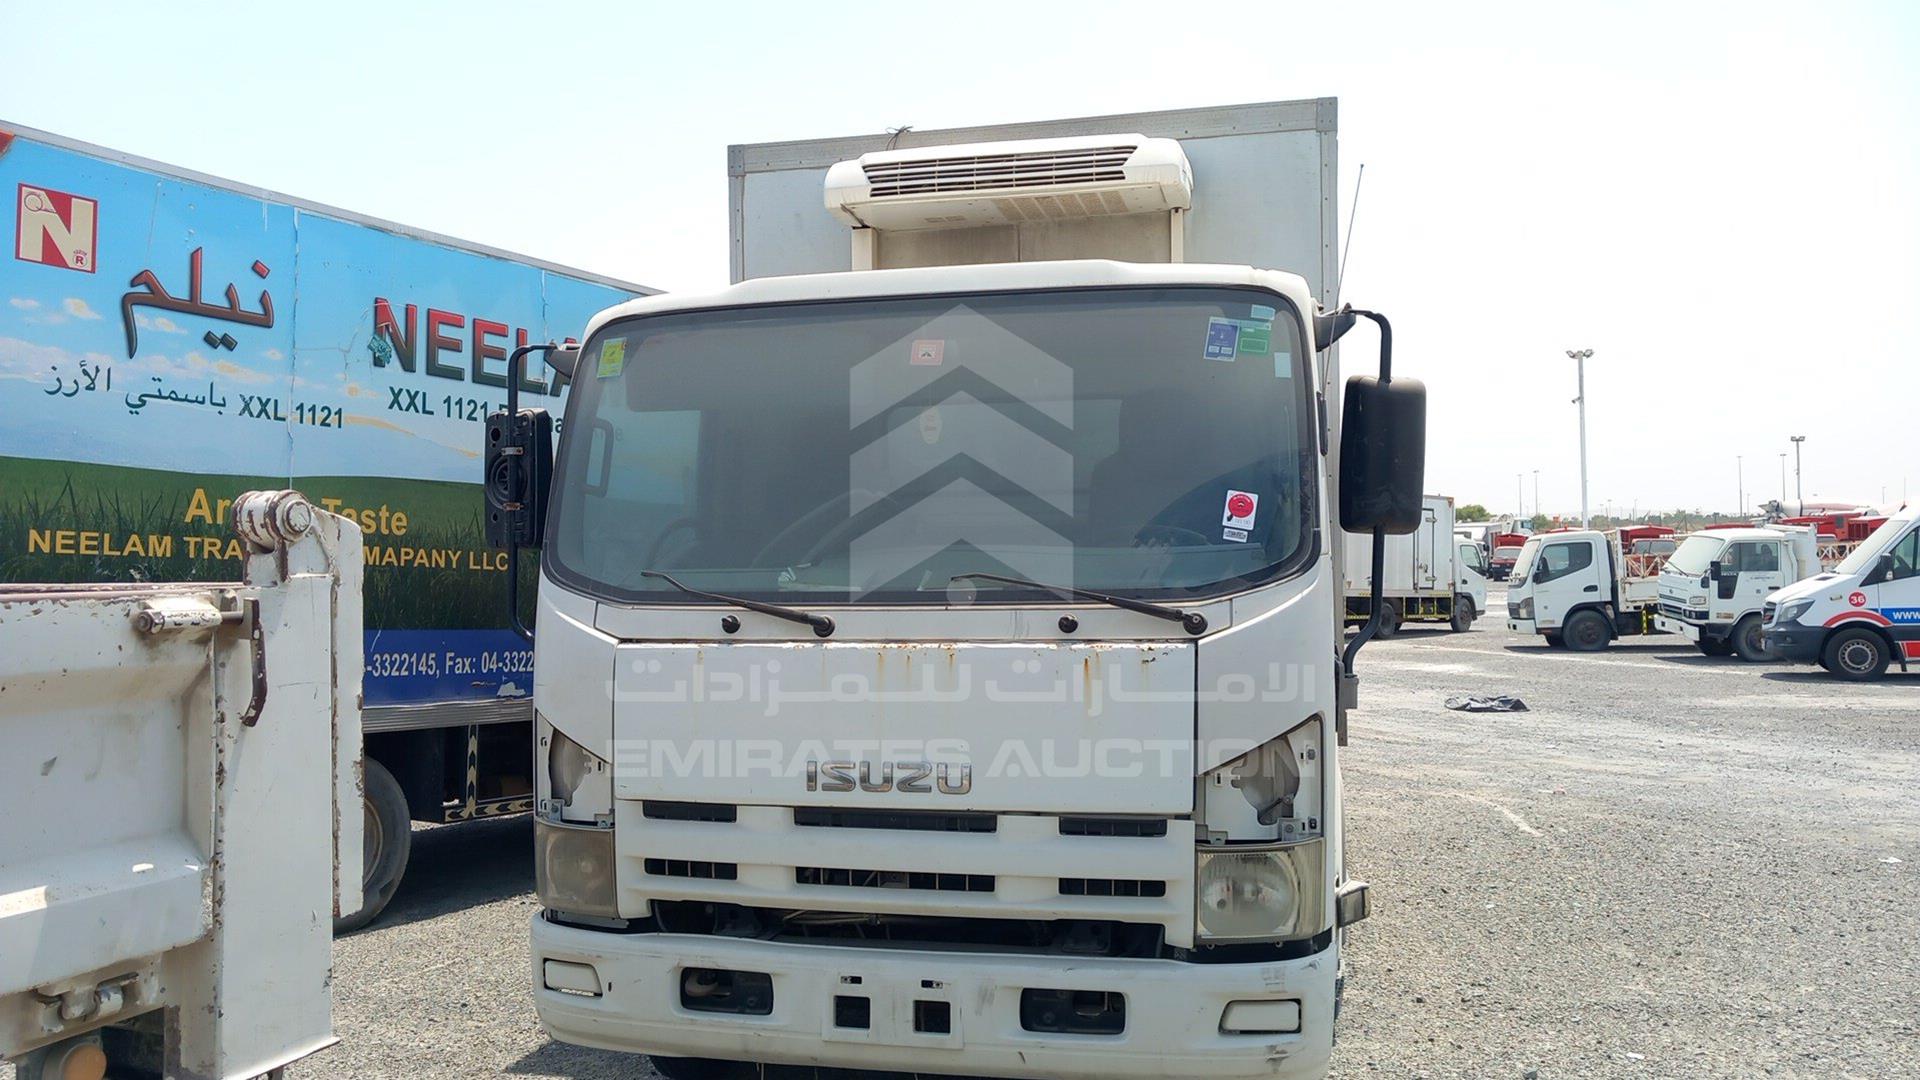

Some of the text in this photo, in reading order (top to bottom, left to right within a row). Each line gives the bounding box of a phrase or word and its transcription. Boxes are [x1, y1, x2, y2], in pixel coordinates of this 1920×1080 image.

[121, 246, 275, 359] نيلم
[43, 359, 342, 428] XXL 1121 باسمتي الأرز
[388, 386, 434, 416] XXL
[443, 395, 488, 422] 1121
[184, 488, 231, 524] Ar
[28, 529, 508, 570] NEELAM TRA MAPANY LLC
[1850, 595, 1865, 604] 36
[363, 651, 534, 678] -3322145, Fax: 04-3322
[806, 760, 972, 794] ISUZU
